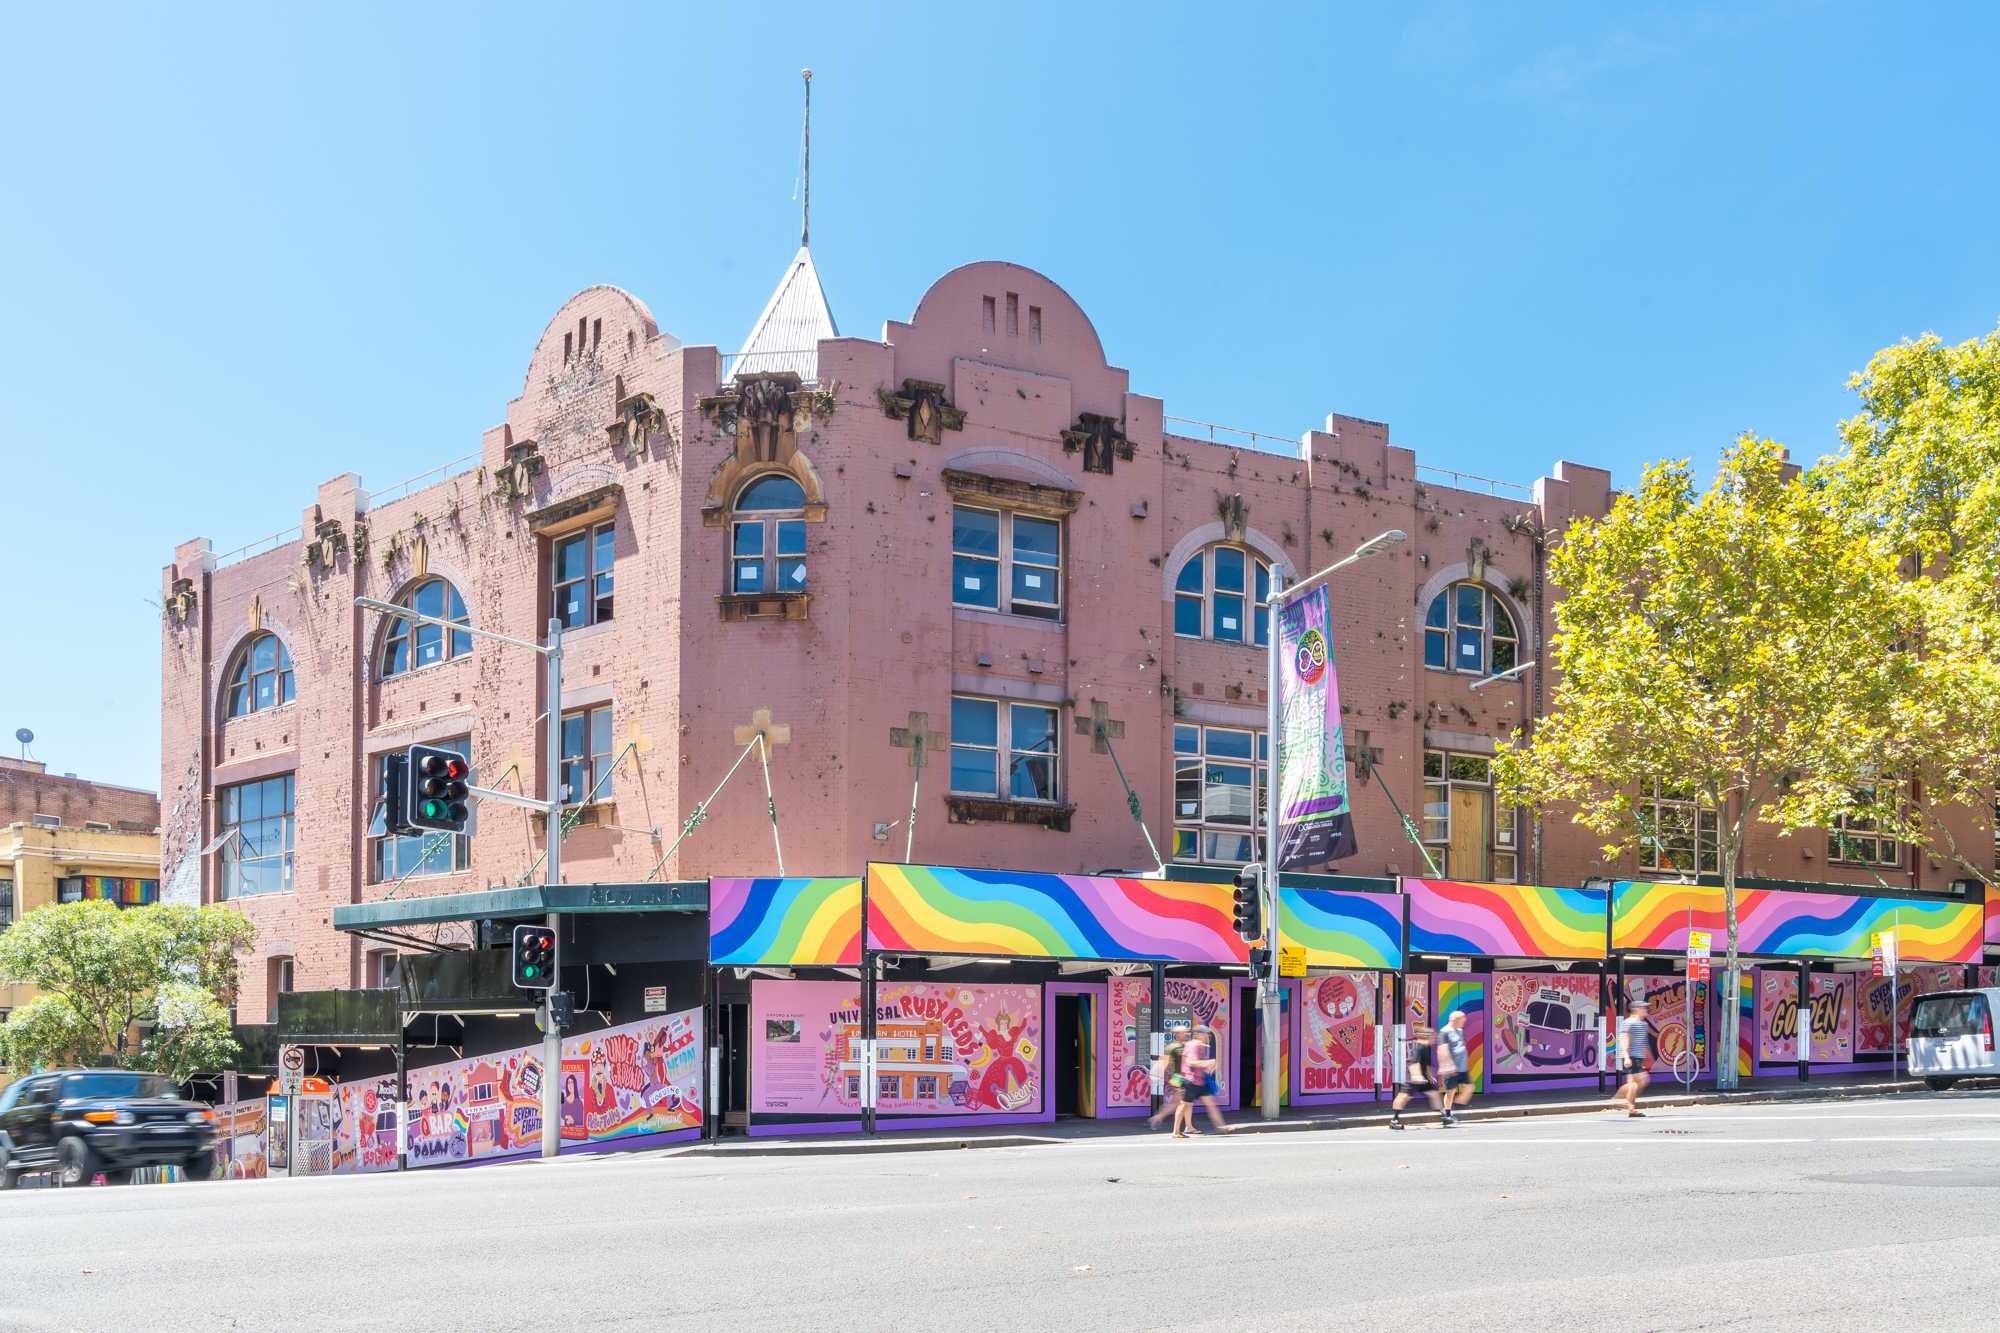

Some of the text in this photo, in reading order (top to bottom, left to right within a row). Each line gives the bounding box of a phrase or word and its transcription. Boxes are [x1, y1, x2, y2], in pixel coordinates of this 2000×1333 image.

[242, 834, 274, 845] GOWTHBUILT
[1405, 979, 1425, 999] MME
[1648, 984, 1693, 1015] EXILES
[829, 1006, 901, 1024] UNIVSAL
[899, 995, 948, 1021] RUBY
[1148, 981, 1218, 1027] RSECTIONAL
[1773, 985, 1843, 1039] GODEN
[851, 1030, 918, 1038] UNORN HOTEL
[943, 1007, 979, 1058] REDS
[1675, 1028, 1685, 1037] GAY
[1694, 981, 1706, 1068] DARLINGHURST
[607, 1035, 638, 1066] UNDER
[668, 1030, 695, 1055] XXX
[1112, 981, 1124, 1102] CRICKETER'S ARMS
[667, 1047, 696, 1078] WEIRD!
[610, 1062, 644, 1092] GROUND
[1304, 1067, 1393, 1090] BUCKING
[651, 1088, 680, 1104] VOGUING
[997, 1077, 1039, 1110] Queens
[513, 1107, 539, 1125] SEVENTY
[522, 1118, 543, 1136] EIGHTE
[587, 1115, 603, 1130] Peter
[340, 1143, 357, 1165] koori
